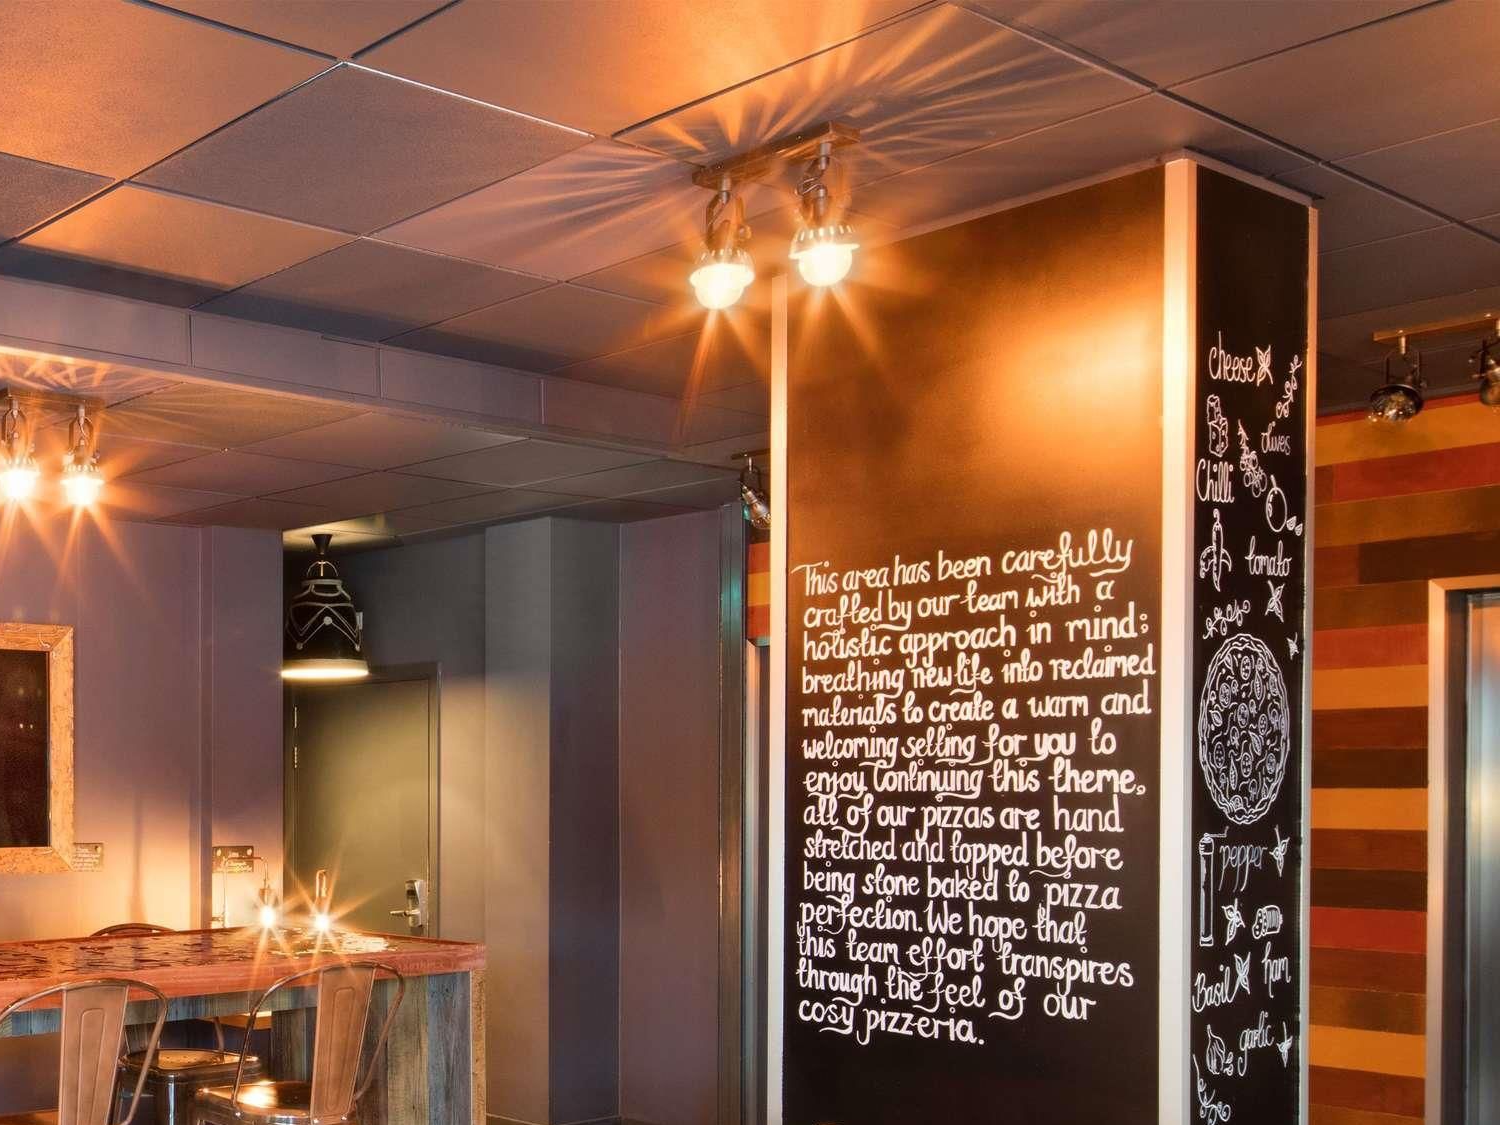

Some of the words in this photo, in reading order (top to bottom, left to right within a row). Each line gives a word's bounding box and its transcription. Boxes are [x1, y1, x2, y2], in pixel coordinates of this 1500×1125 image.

[1209, 331, 1256, 383] cheese
[1261, 421, 1291, 455] olives
[1196, 458, 1235, 503] Chilli
[791, 560, 839, 596] This
[842, 567, 890, 592] area
[893, 554, 931, 586] has
[938, 550, 991, 582] been
[1001, 527, 1133, 583] carefully
[1245, 536, 1292, 576] tomato
[803, 592, 883, 637] crafted
[870, 589, 912, 632] by
[917, 594, 960, 618] our
[960, 580, 1018, 614] team
[1025, 571, 1081, 608] with
[1096, 580, 1115, 600] a
[803, 624, 893, 661] holistic
[898, 614, 1016, 668] approach
[1026, 610, 1051, 644] in
[802, 658, 905, 699] breathing
[911, 666, 952, 689] new
[950, 651, 994, 695] life
[1002, 648, 1043, 684] into
[1049, 643, 1156, 681] reclaimed
[802, 693, 897, 727] materials
[902, 691, 924, 723] to
[928, 691, 995, 722] create
[1002, 698, 1019, 719] a
[1027, 695, 1089, 718] warm
[1101, 678, 1152, 715] and
[802, 726, 899, 768] welcoming
[901, 723, 977, 765] setting
[970, 723, 1028, 766] for
[1015, 732, 1077, 763] you
[1087, 717, 1117, 755] to
[987, 758, 1041, 793] this
[803, 795, 839, 825] all
[832, 793, 875, 837] of
[876, 805, 916, 827] our
[916, 799, 995, 842] pizzas
[1000, 807, 1041, 830] are
[1053, 793, 1124, 832] hand
[803, 829, 897, 859] stretched
[902, 828, 946, 863] and
[949, 829, 1030, 881] topped
[1029, 831, 1124, 877] before
[1219, 844, 1267, 893] pepper
[803, 860, 855, 902] being
[861, 863, 920, 896] stone
[927, 865, 999, 901] baked
[1006, 869, 1030, 902] to
[1038, 872, 1123, 921] pizza
[798, 894, 924, 936] perfection.
[923, 900, 963, 935] We
[969, 900, 1027, 953] hope
[1032, 910, 1088, 945] that
[797, 926, 836, 958] this
[846, 928, 900, 965] team
[906, 937, 985, 981] effort
[996, 942, 1134, 996] transpires
[796, 957, 877, 1006] through
[885, 965, 924, 1002] the
[913, 972, 986, 1013] feel
[989, 977, 1027, 1020] of
[1043, 993, 1097, 1020] our
[1192, 964, 1238, 1013] Basil
[798, 1000, 855, 1035] cosy
[857, 998, 985, 1045] pizzeria.
[1238, 1010, 1274, 1076] garlic
